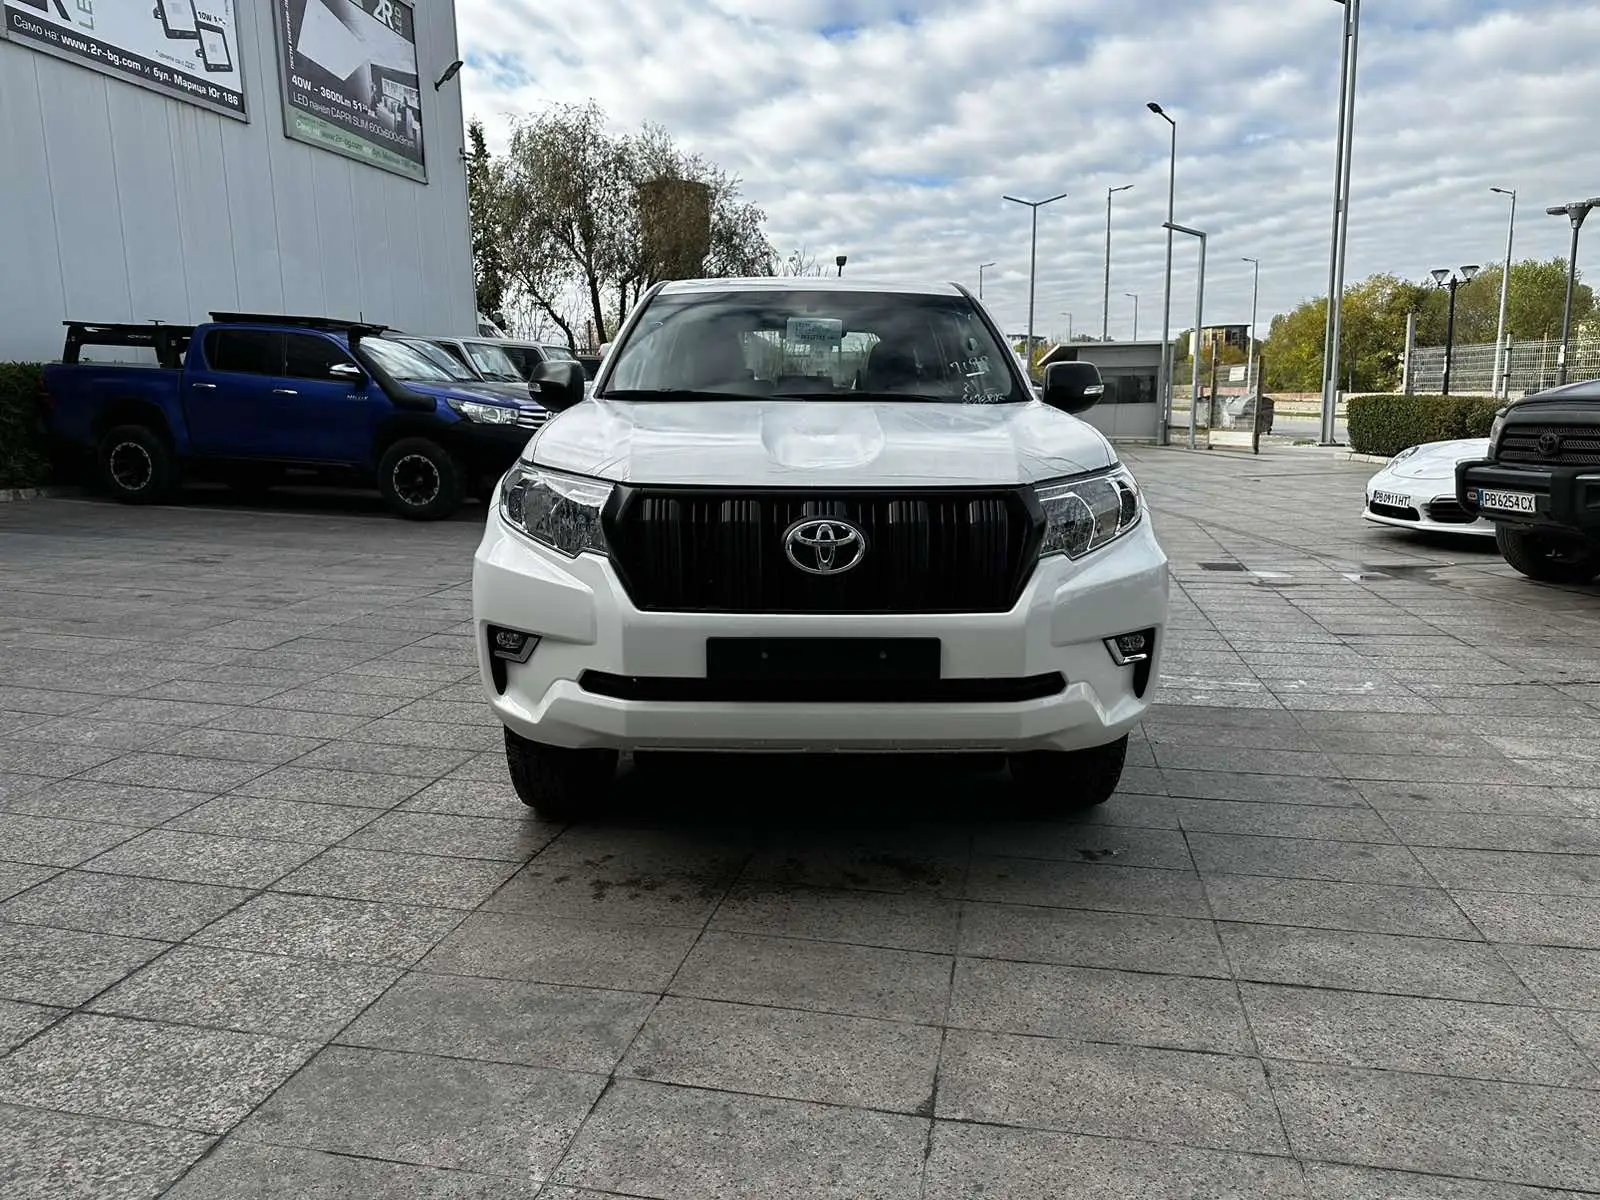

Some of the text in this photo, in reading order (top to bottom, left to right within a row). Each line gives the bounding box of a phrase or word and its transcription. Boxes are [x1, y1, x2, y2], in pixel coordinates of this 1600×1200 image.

[13, 14, 43, 34] Само
[44, 29, 60, 42] на:
[60, 34, 141, 71] www.2r-bg.com
[144, 64, 151, 74] и
[153, 67, 172, 82] бул.
[173, 73, 207, 95] Марица
[208, 86, 221, 99] Юг
[222, 91, 239, 105] 186
[291, 75, 311, 91] 40W
[320, 86, 352, 108] 3600Lm
[293, 91, 309, 106] LED
